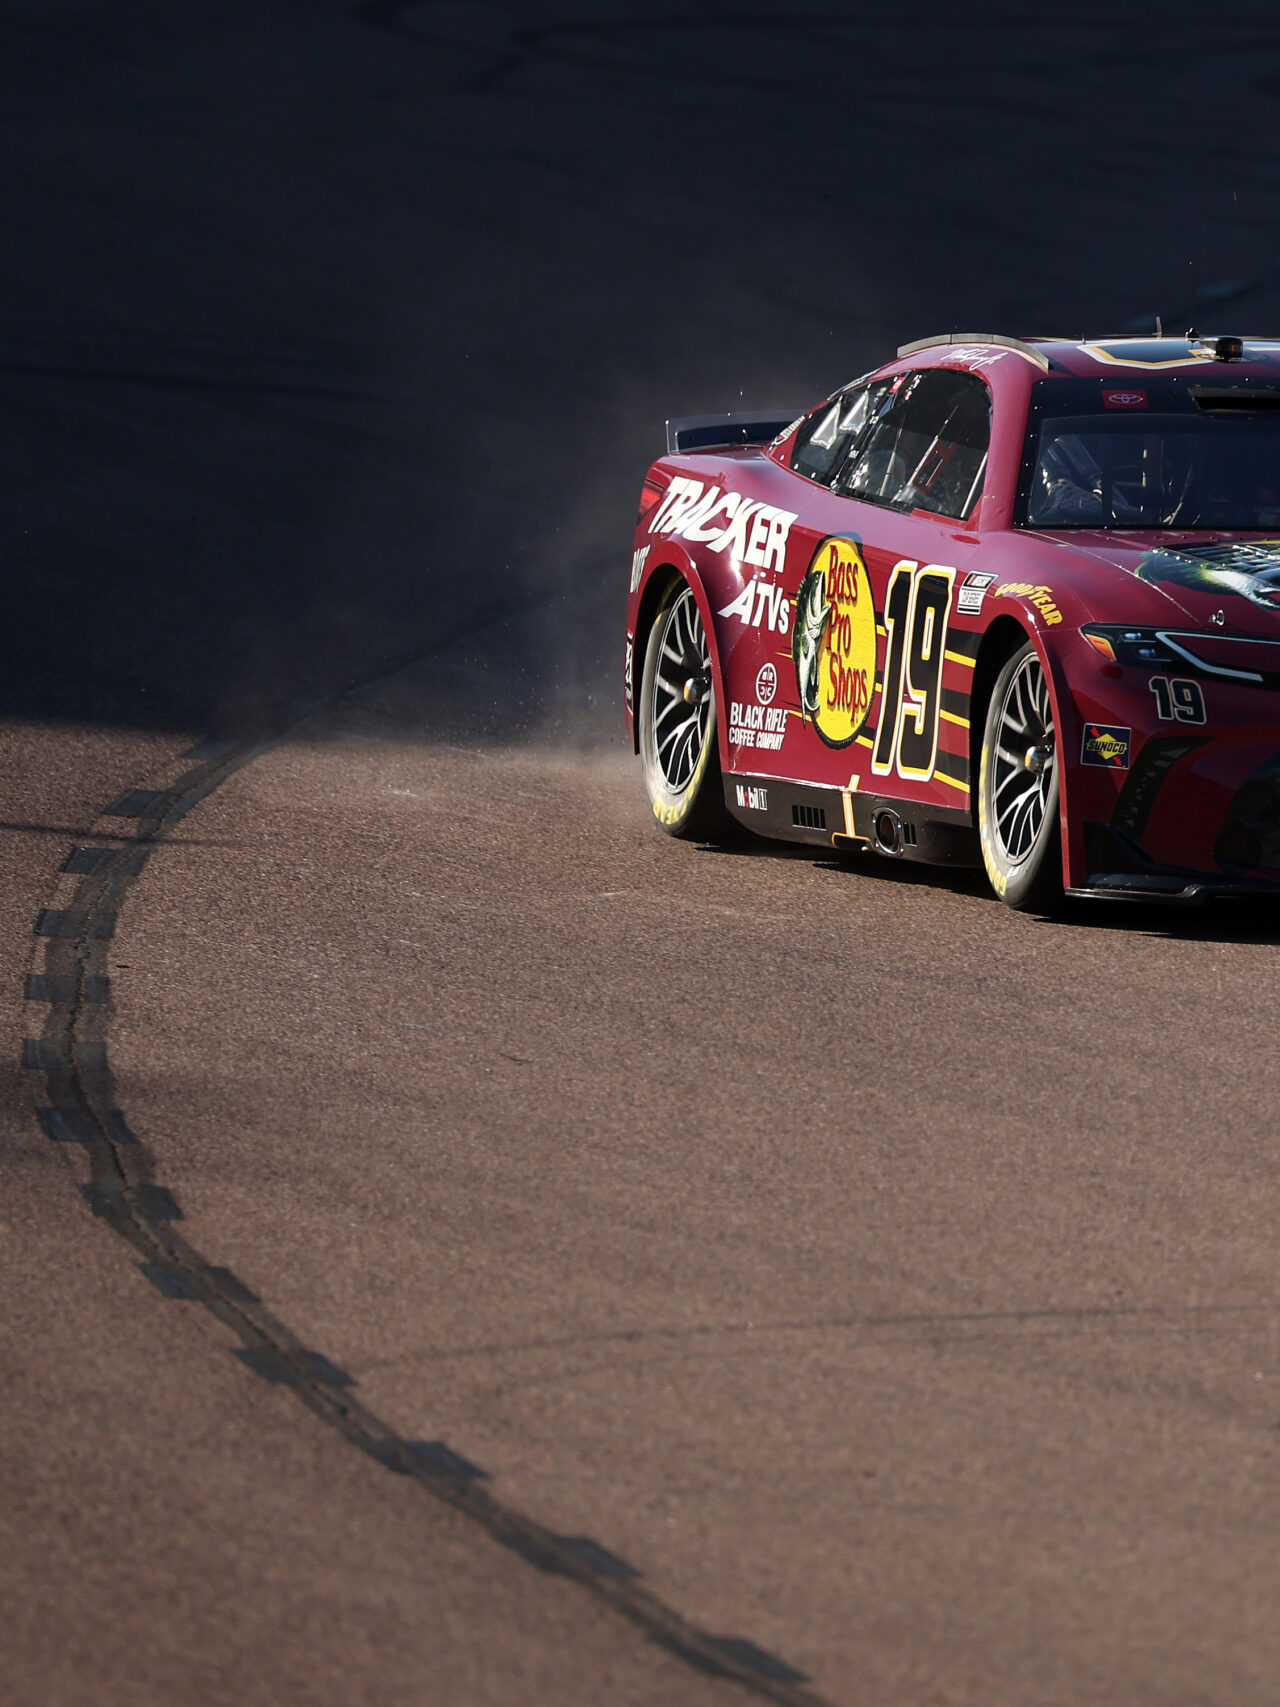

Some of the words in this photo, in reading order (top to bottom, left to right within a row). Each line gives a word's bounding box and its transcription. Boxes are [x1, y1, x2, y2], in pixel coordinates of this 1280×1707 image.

[648, 476, 799, 573] TRACKER
[826, 544, 859, 602] Bass
[717, 579, 790, 634] ATVs
[826, 600, 853, 659] Pro
[994, 583, 1063, 626] GOODYEAR
[827, 652, 868, 726] Shops
[871, 560, 957, 782] 19
[730, 702, 765, 730] BLACK
[764, 709, 789, 733] RIFLE
[1149, 676, 1207, 725] 19
[728, 727, 755, 748] COFFEE
[756, 731, 785, 751] COMPANY
[1087, 739, 1127, 754] SUNOCO
[736, 785, 759, 810] Mobil
